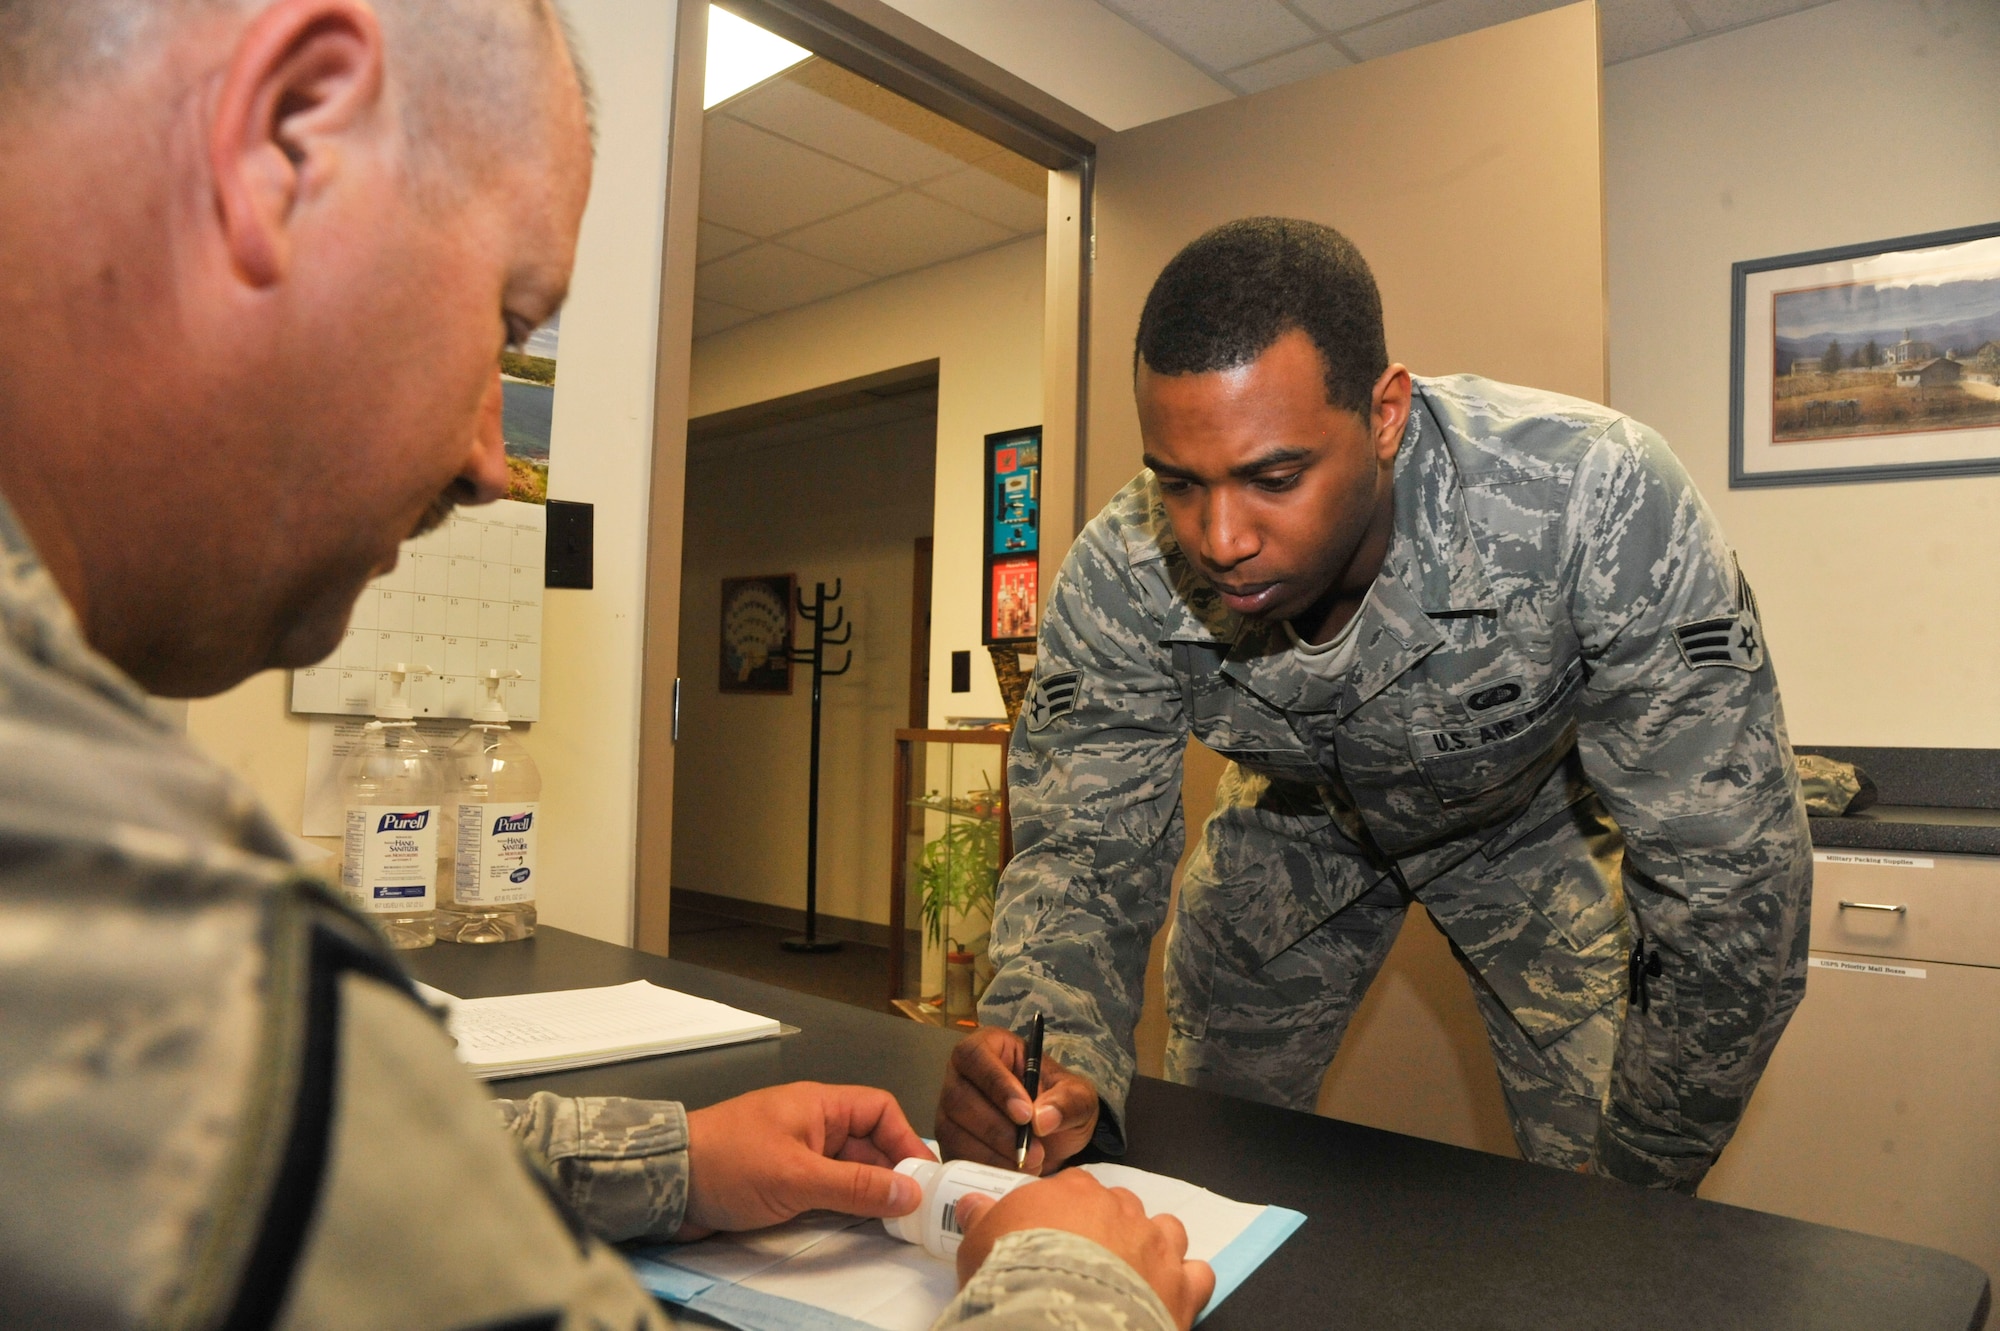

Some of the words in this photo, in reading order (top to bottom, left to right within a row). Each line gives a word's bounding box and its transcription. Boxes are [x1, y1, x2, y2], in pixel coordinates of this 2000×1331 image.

[1480, 720, 1516, 744] AIR
[384, 814, 425, 829] Purell
[498, 818, 530, 831] Purell
[1840, 963, 1865, 971] Priority
